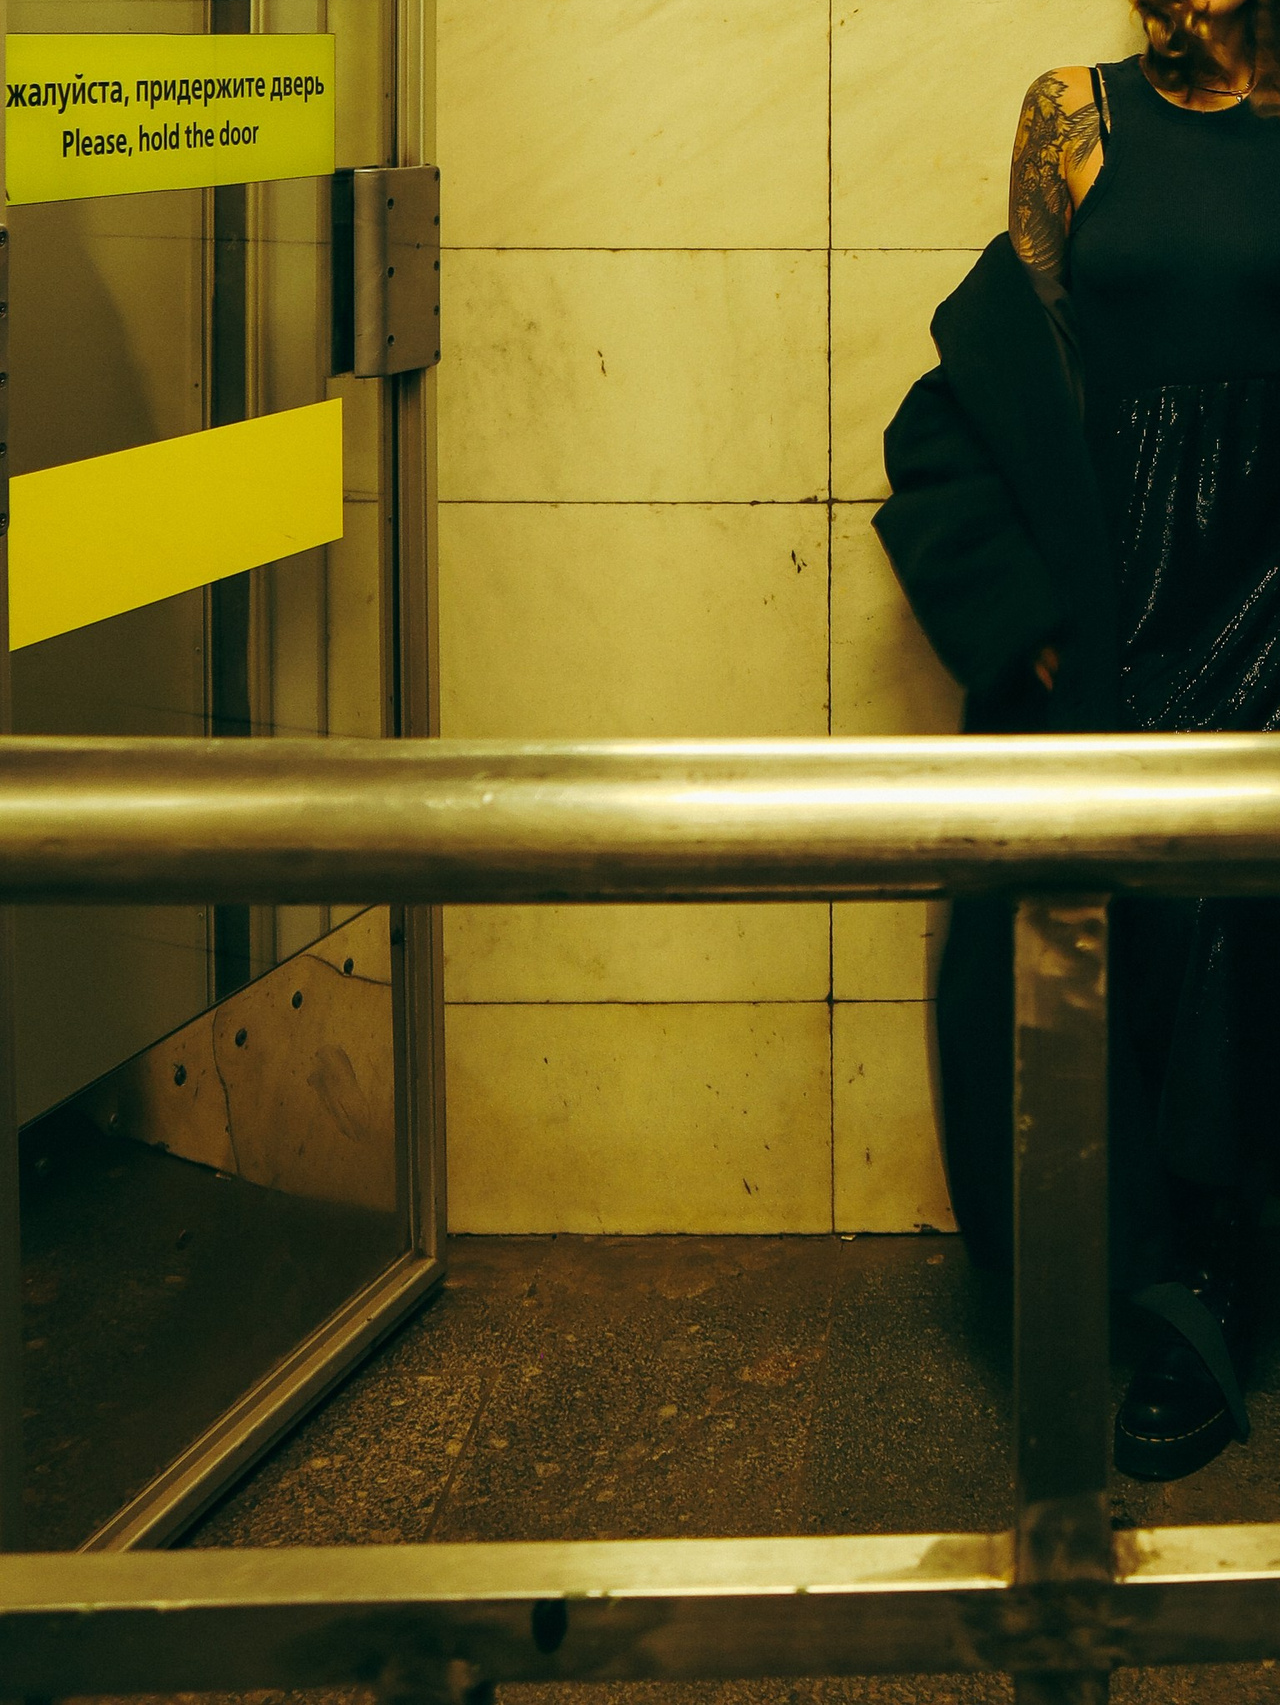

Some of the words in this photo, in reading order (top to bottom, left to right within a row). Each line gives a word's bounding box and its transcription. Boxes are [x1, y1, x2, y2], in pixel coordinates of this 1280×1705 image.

[5, 73, 130, 115] жалуйста,
[136, 75, 266, 110] придержите
[270, 75, 325, 103] дверь
[62, 127, 133, 158] Please,
[138, 122, 180, 152] hold
[184, 121, 215, 149] the
[219, 120, 259, 146] door
